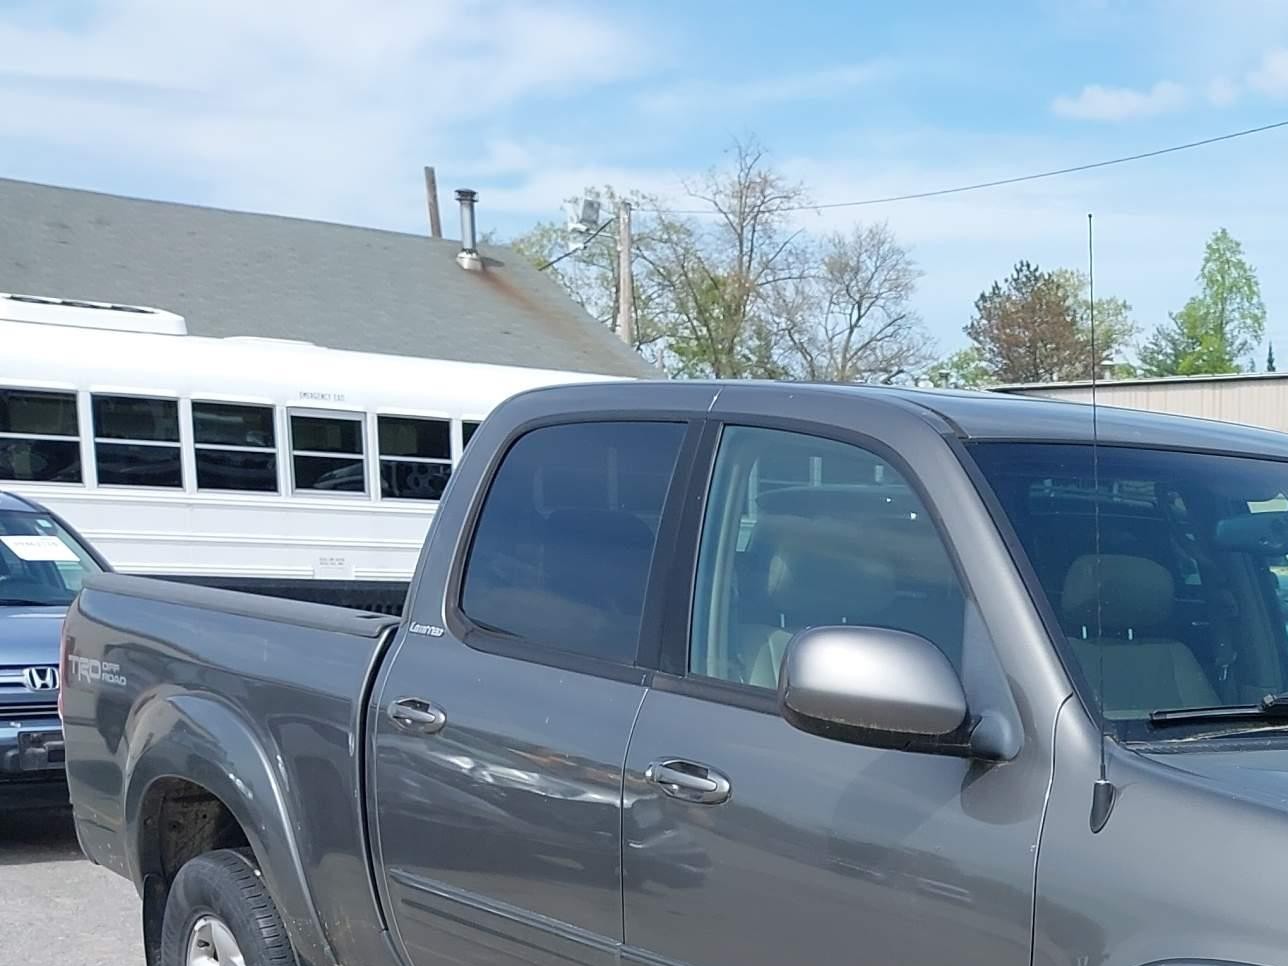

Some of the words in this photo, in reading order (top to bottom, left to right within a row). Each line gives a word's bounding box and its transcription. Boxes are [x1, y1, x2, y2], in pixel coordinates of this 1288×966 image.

[68, 654, 101, 684] TRD
[102, 661, 120, 673] OFF
[102, 672, 127, 686] ROAD
